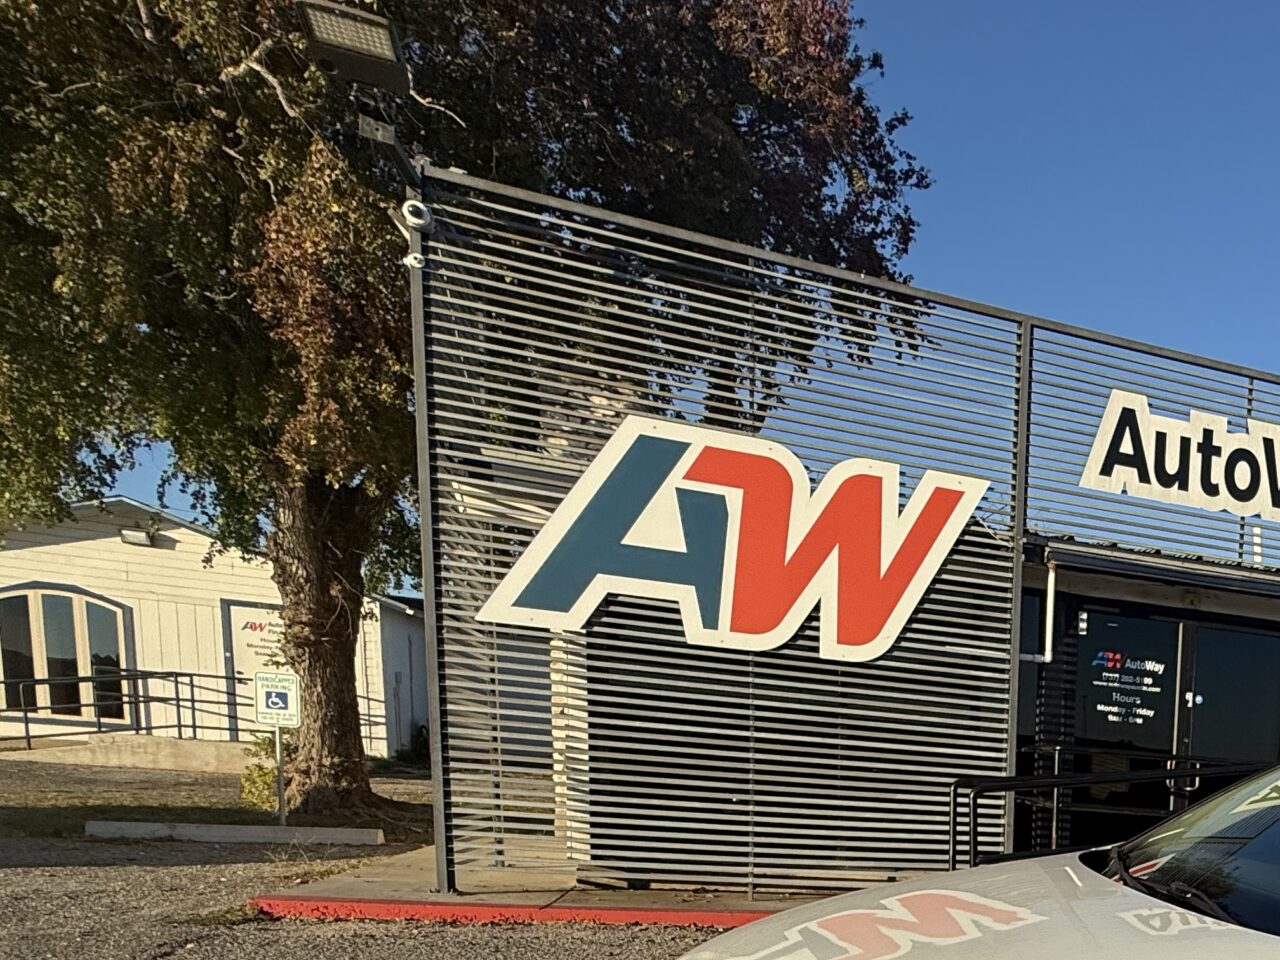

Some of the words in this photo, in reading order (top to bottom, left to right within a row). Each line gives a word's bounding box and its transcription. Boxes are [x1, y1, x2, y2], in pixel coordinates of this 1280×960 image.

[511, 434, 965, 646] AW
[1125, 659, 1165, 674] AutoWay
[1112, 692, 1141, 704] Hours
[1097, 704, 1126, 714] Monday
[1132, 707, 1155, 717] Friday
